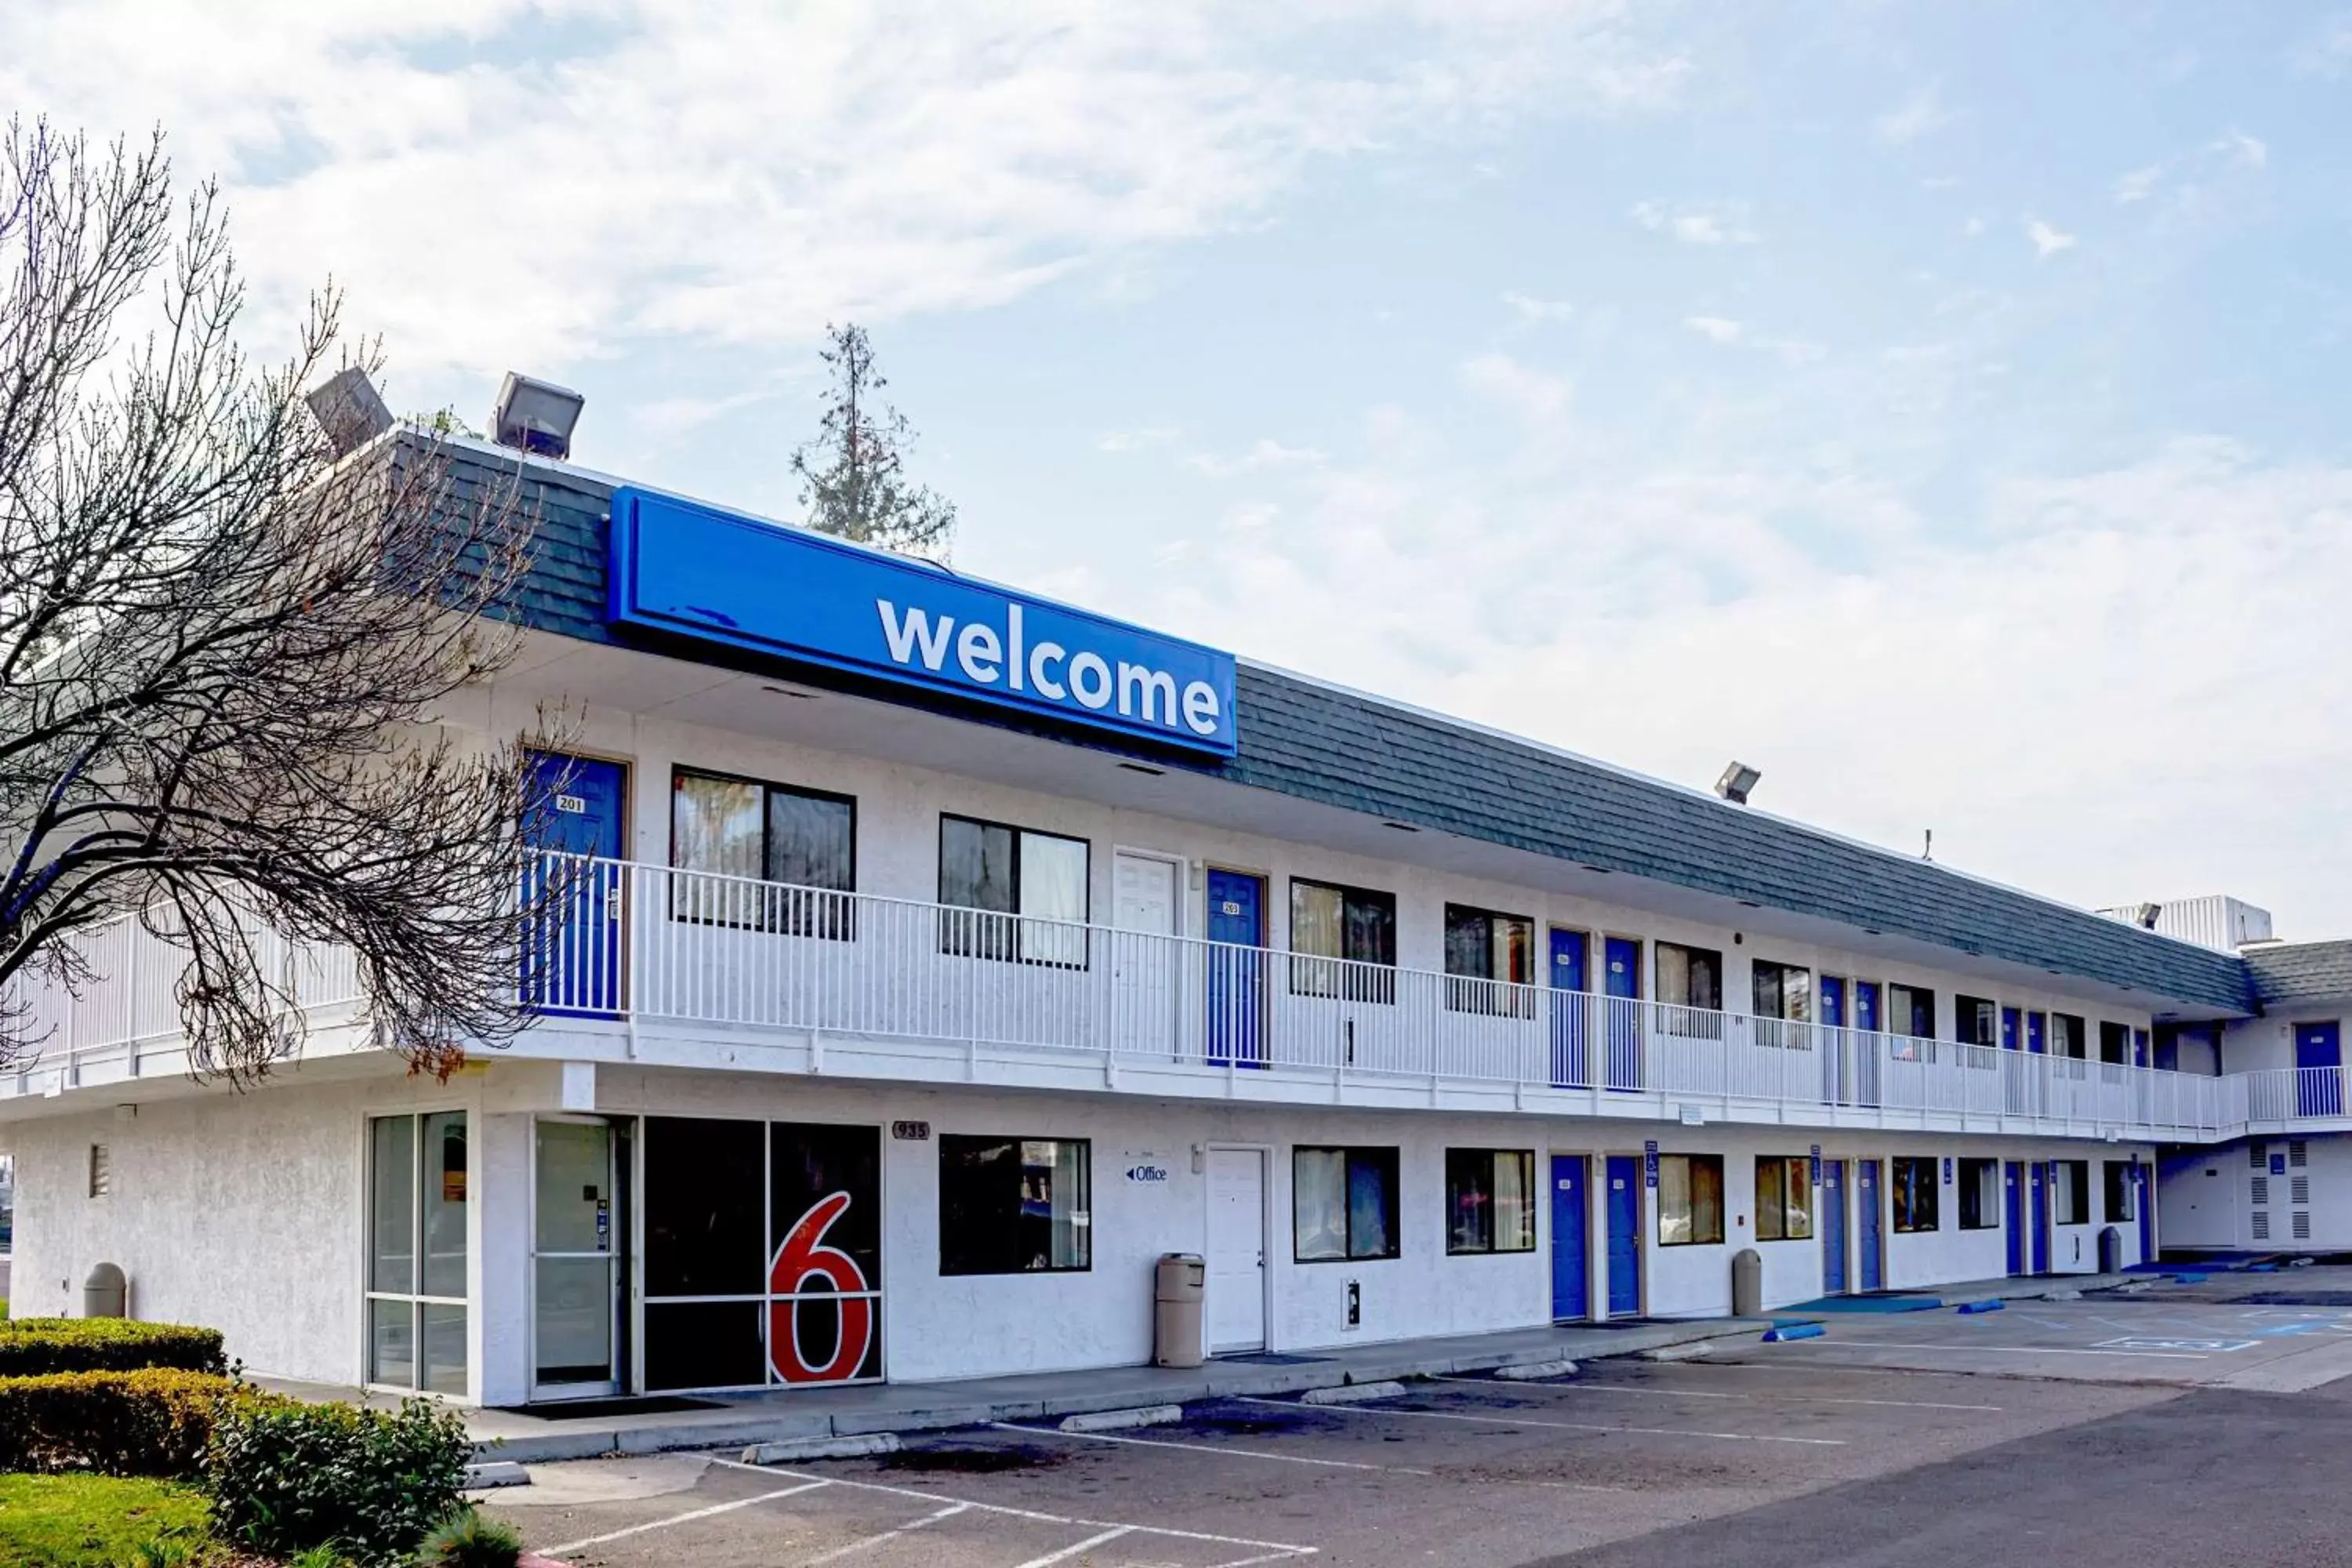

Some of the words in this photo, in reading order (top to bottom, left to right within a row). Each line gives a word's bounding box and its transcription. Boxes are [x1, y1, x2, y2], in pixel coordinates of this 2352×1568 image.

[877, 600, 1220, 735] welcome
[560, 797, 581, 811] 201
[898, 1122, 926, 1138] 935
[1136, 1166, 1167, 1181] Office
[769, 1191, 873, 1384] 6
